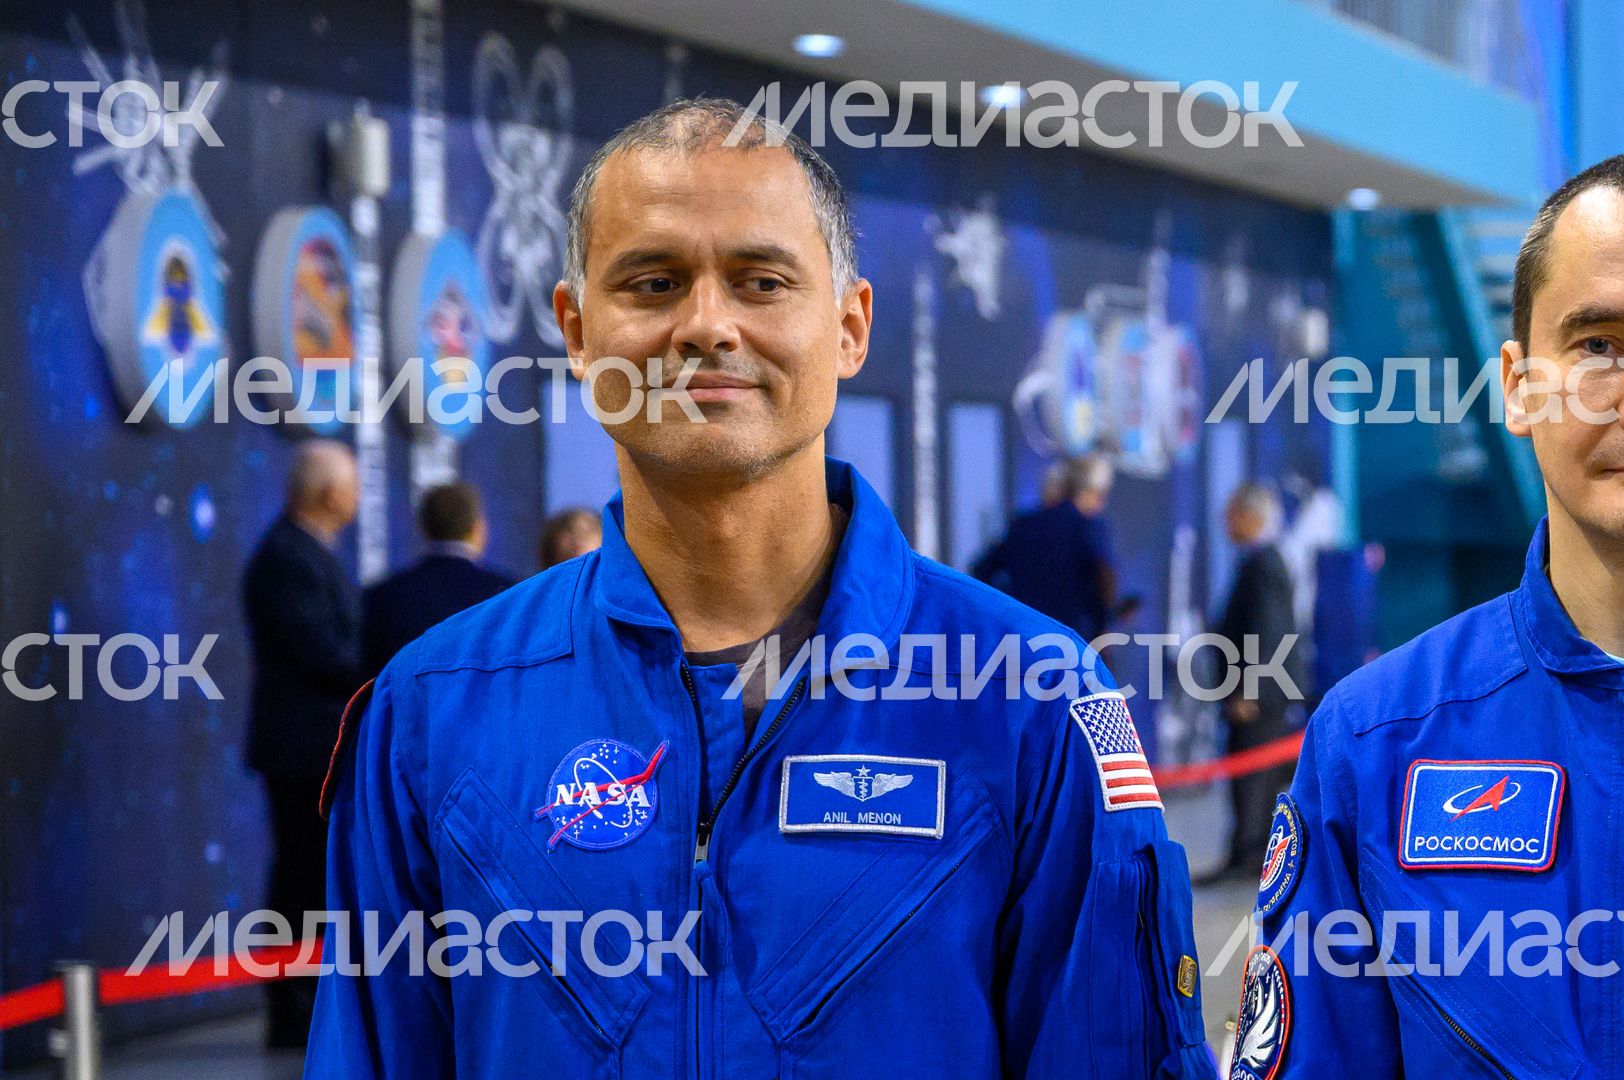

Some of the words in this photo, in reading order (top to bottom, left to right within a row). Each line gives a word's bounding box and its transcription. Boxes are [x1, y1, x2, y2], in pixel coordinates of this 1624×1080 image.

[553, 782, 651, 807] NASA
[823, 811, 851, 823] ANIL
[857, 812, 902, 825] MENON
[1414, 835, 1540, 854] РОСКОСМОС
